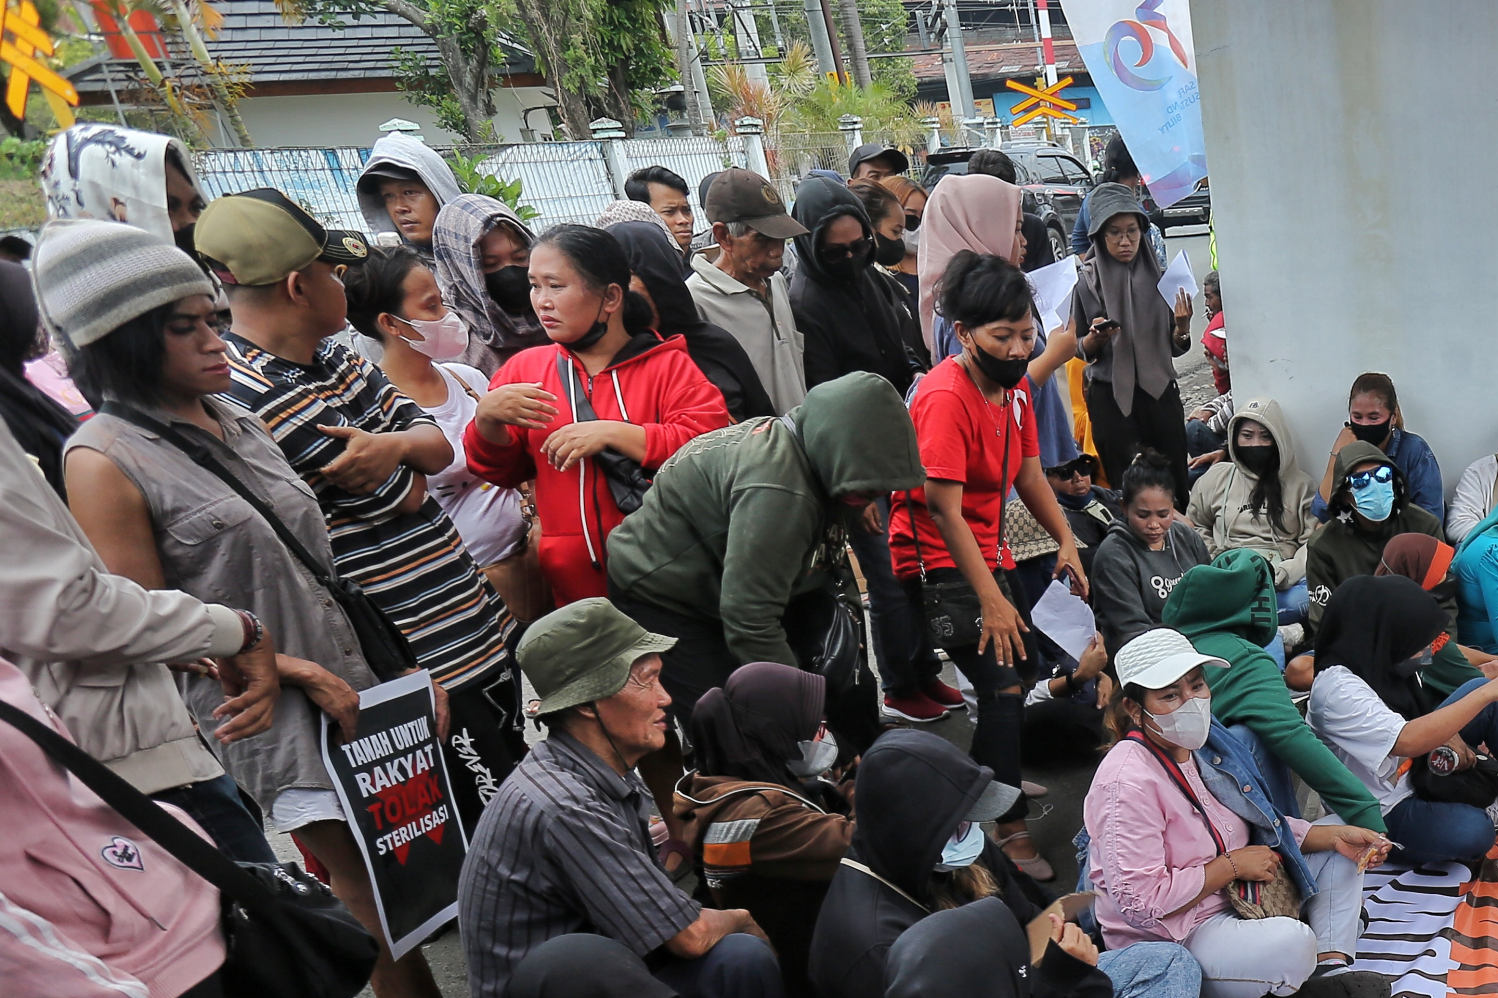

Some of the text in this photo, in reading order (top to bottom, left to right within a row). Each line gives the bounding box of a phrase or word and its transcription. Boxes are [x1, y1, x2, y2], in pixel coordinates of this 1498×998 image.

[340, 715, 431, 768] TANAH UNTUK
[354, 743, 435, 798] RAKYAT
[367, 774, 443, 831] TOLAK
[375, 803, 449, 856] STERILISASI
